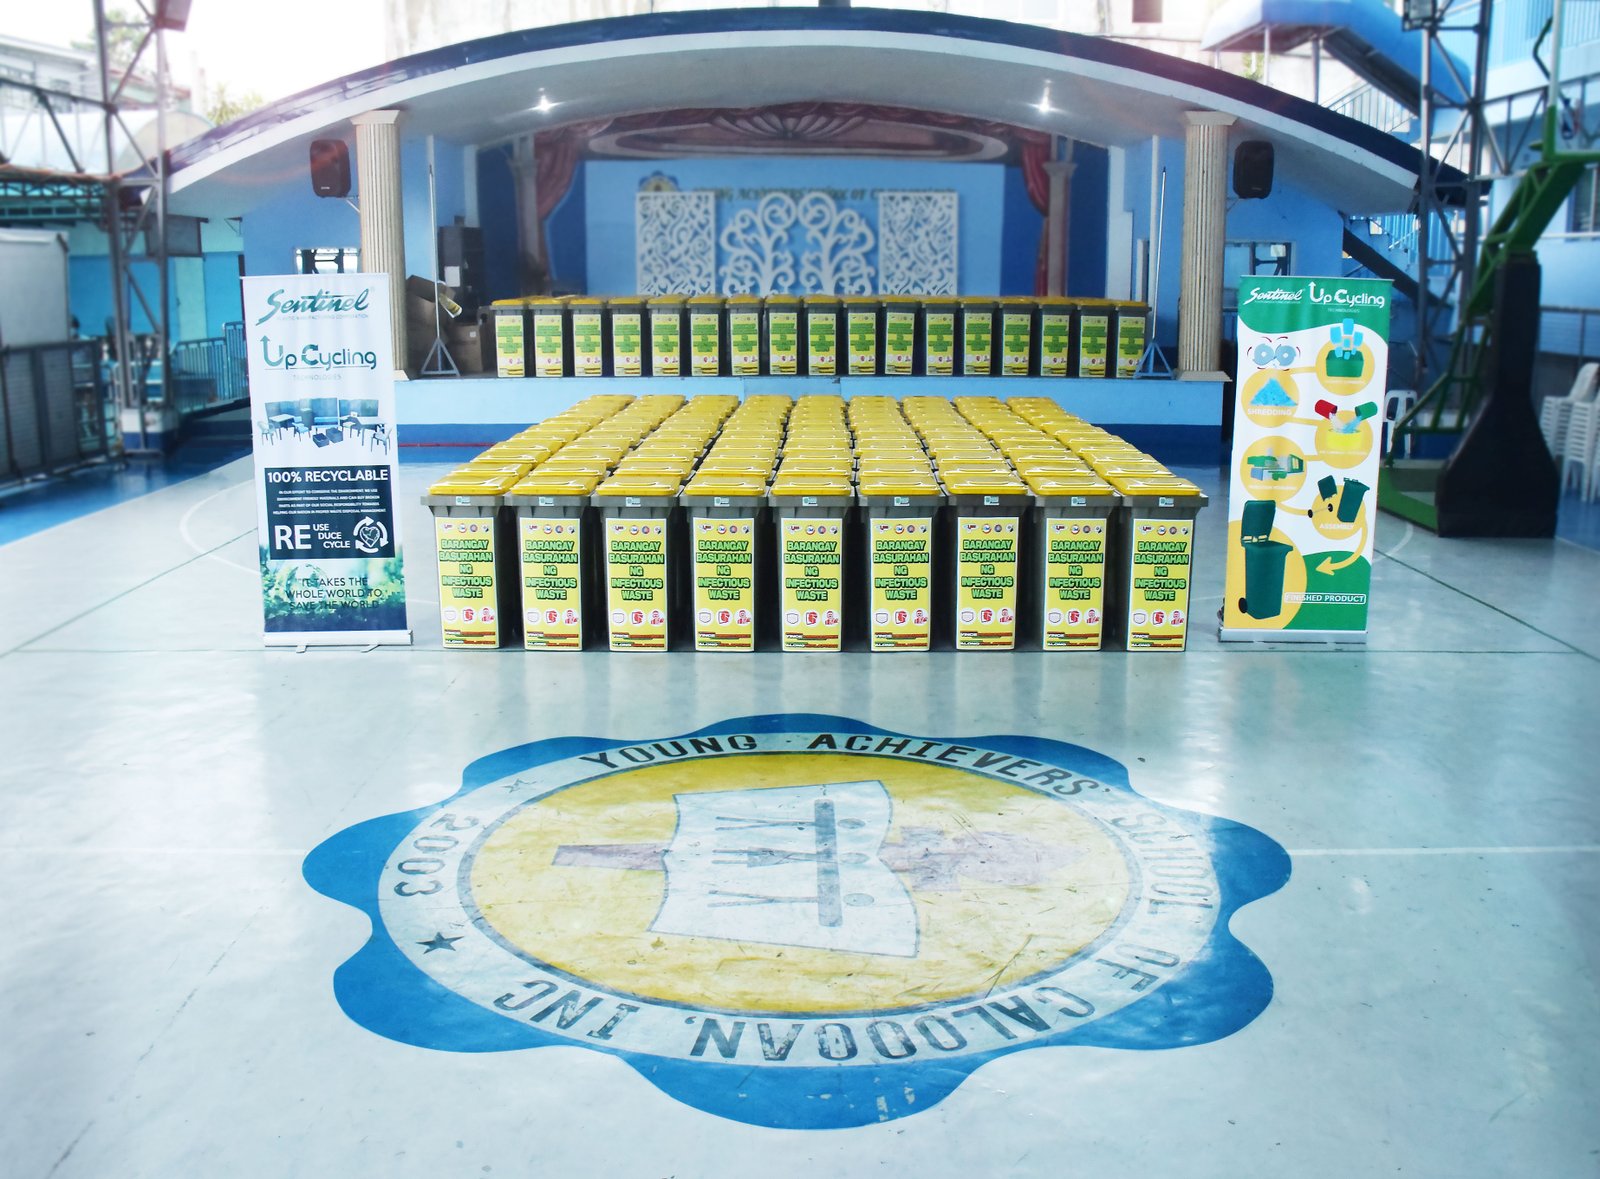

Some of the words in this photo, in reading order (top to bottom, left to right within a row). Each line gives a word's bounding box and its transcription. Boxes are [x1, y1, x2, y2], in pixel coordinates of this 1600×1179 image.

[1243, 287, 1303, 305] Sentinel
[256, 288, 369, 326] Sentinel
[1247, 408, 1293, 416] SHREDDING
[267, 471, 302, 483] 100%
[305, 469, 388, 483] RECYCLABLE
[313, 523, 330, 531] USE
[274, 524, 312, 550] RE
[318, 532, 342, 540] DUCE
[323, 541, 351, 549] CYCLE
[441, 539, 488, 550] BARANGAY
[525, 540, 574, 551] BARANGAY
[611, 541, 661, 551] BARANGAY
[699, 540, 748, 551] BARANGAY
[787, 541, 837, 551] BARANGAY
[876, 540, 926, 551] BARANGAY
[963, 540, 1012, 550] BARANGAY
[1052, 541, 1101, 551] BARANGAY
[1138, 541, 1187, 552] BARANGAY
[440, 551, 493, 562] BASURAHAN
[523, 552, 578, 563] BASURAHAN
[609, 554, 664, 564] BASURAHAN
[696, 553, 751, 563] BASURAHAN
[784, 553, 840, 564] BASURAHAN
[874, 553, 929, 563] BASURAHAN
[960, 552, 1015, 562] BASURAHAN
[1049, 553, 1103, 563] BASURAHAN
[1135, 554, 1188, 565] BASURAHAN
[459, 564, 473, 574] NG
[543, 565, 557, 575] NG
[629, 566, 643, 576] NG
[716, 565, 730, 576] NG
[804, 566, 819, 576] NG
[894, 565, 908, 576] NG
[981, 564, 994, 575] NG
[1069, 565, 1082, 576] NG
[1155, 566, 1168, 577] NG
[313, 577, 346, 587] TAKES
[349, 577, 368, 586] THE
[443, 576, 492, 586] INFECTIOUS
[526, 577, 576, 588] INFECTIOUS
[611, 578, 663, 589] INFECTIOUS
[698, 578, 750, 588] INFECTIOUS
[786, 578, 838, 589] INFECTIOUS
[875, 577, 927, 588] INFECTIOUS
[961, 577, 1013, 587] INFECTIOUS
[1050, 578, 1100, 588] INFECTIOUS
[1135, 578, 1185, 589] INFECTIOUS
[285, 589, 323, 599] WHOLE
[325, 589, 364, 598] WORLD
[368, 588, 382, 597] TO
[452, 588, 483, 598] WASTE
[536, 589, 567, 600] WASTE
[621, 590, 653, 600] WASTE
[708, 589, 739, 600] WASTE
[796, 590, 828, 601] WASTE
[886, 589, 917, 600] WASTE
[972, 588, 1003, 599] WASTE
[1059, 589, 1090, 600] WASTE
[1145, 590, 1175, 601] WASTE
[1285, 593, 1323, 602] FINISHED
[1324, 594, 1364, 603] PRODUCT
[290, 601, 317, 611] SAVE
[319, 600, 336, 610] THE
[340, 600, 379, 609] WORLD
[393, 813, 480, 897] 2003
[579, 734, 758, 769] YOUNG
[1097, 942, 1181, 993] OF
